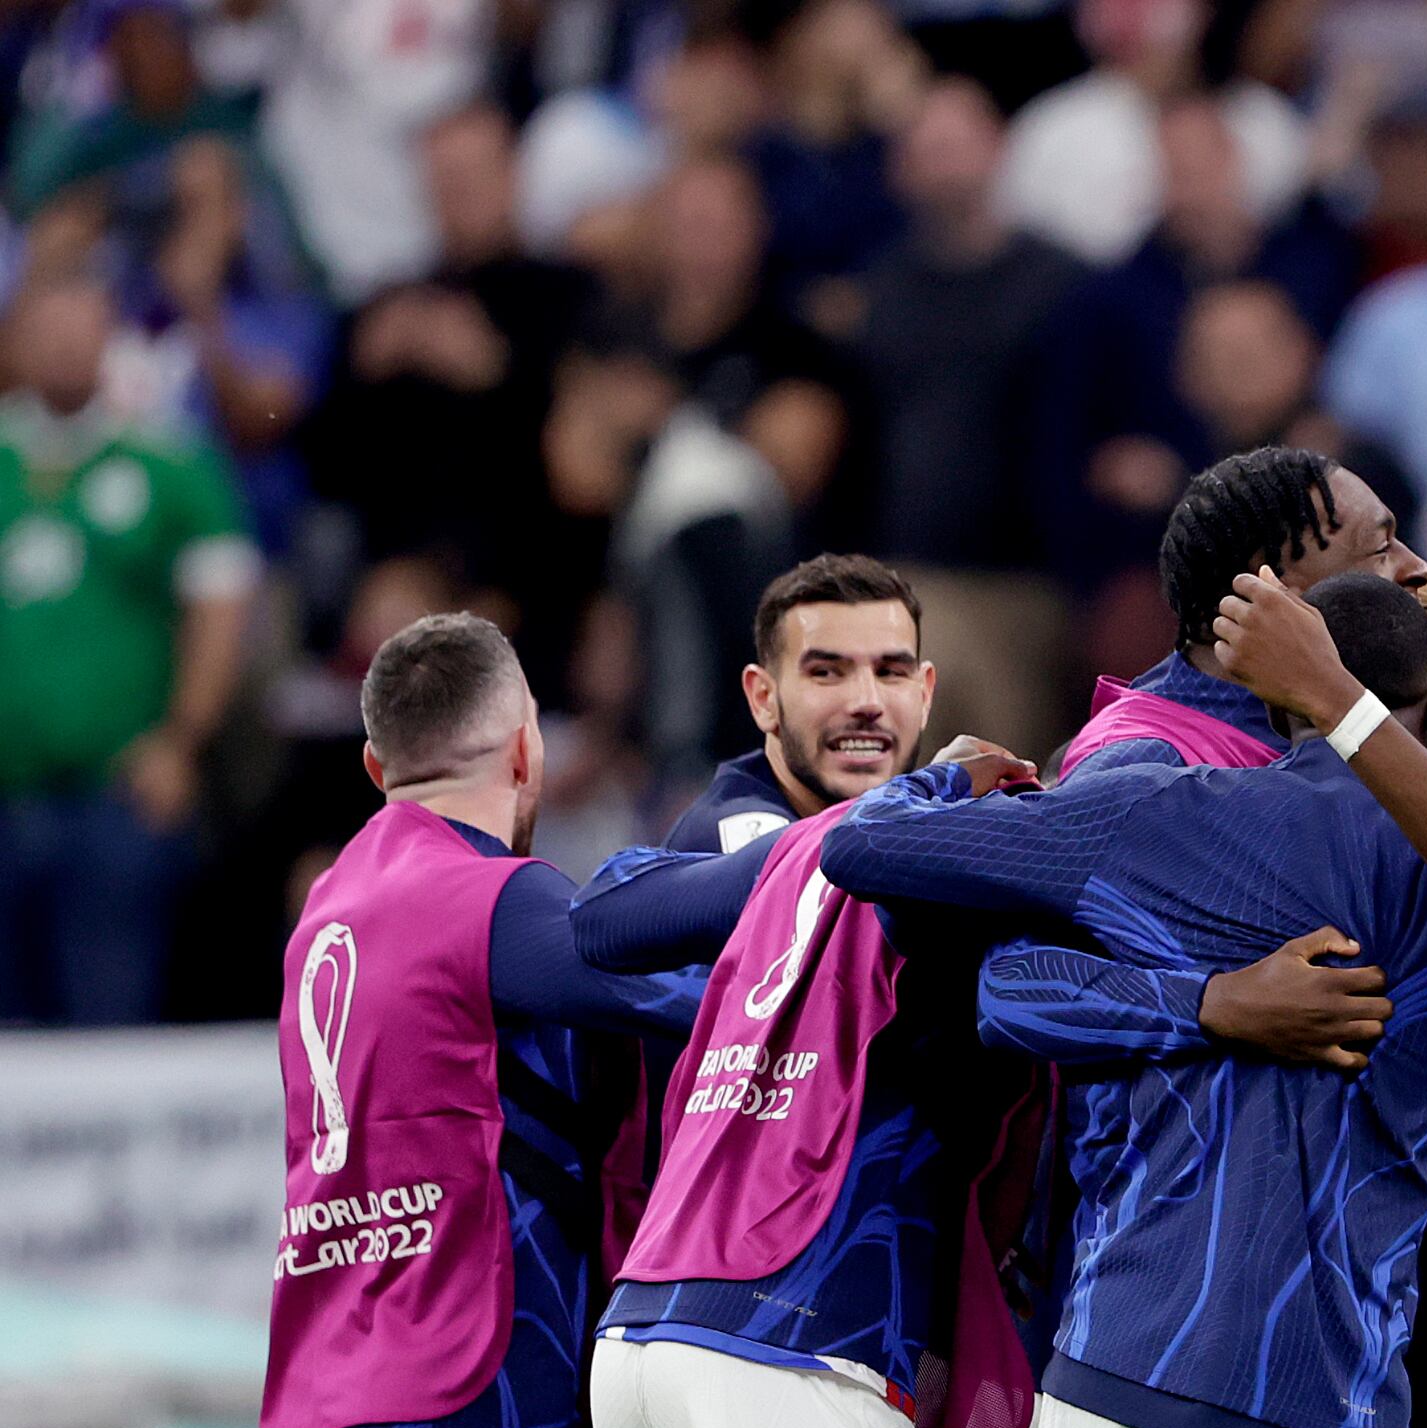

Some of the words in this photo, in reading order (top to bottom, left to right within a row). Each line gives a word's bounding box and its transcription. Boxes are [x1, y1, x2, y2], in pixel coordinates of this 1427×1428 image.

[772, 1052, 819, 1082] CUP
[684, 1077, 794, 1121] atar2022
[289, 1191, 381, 1236] WORLD
[381, 1182, 444, 1219] CUP
[273, 1219, 434, 1281] atar2022
